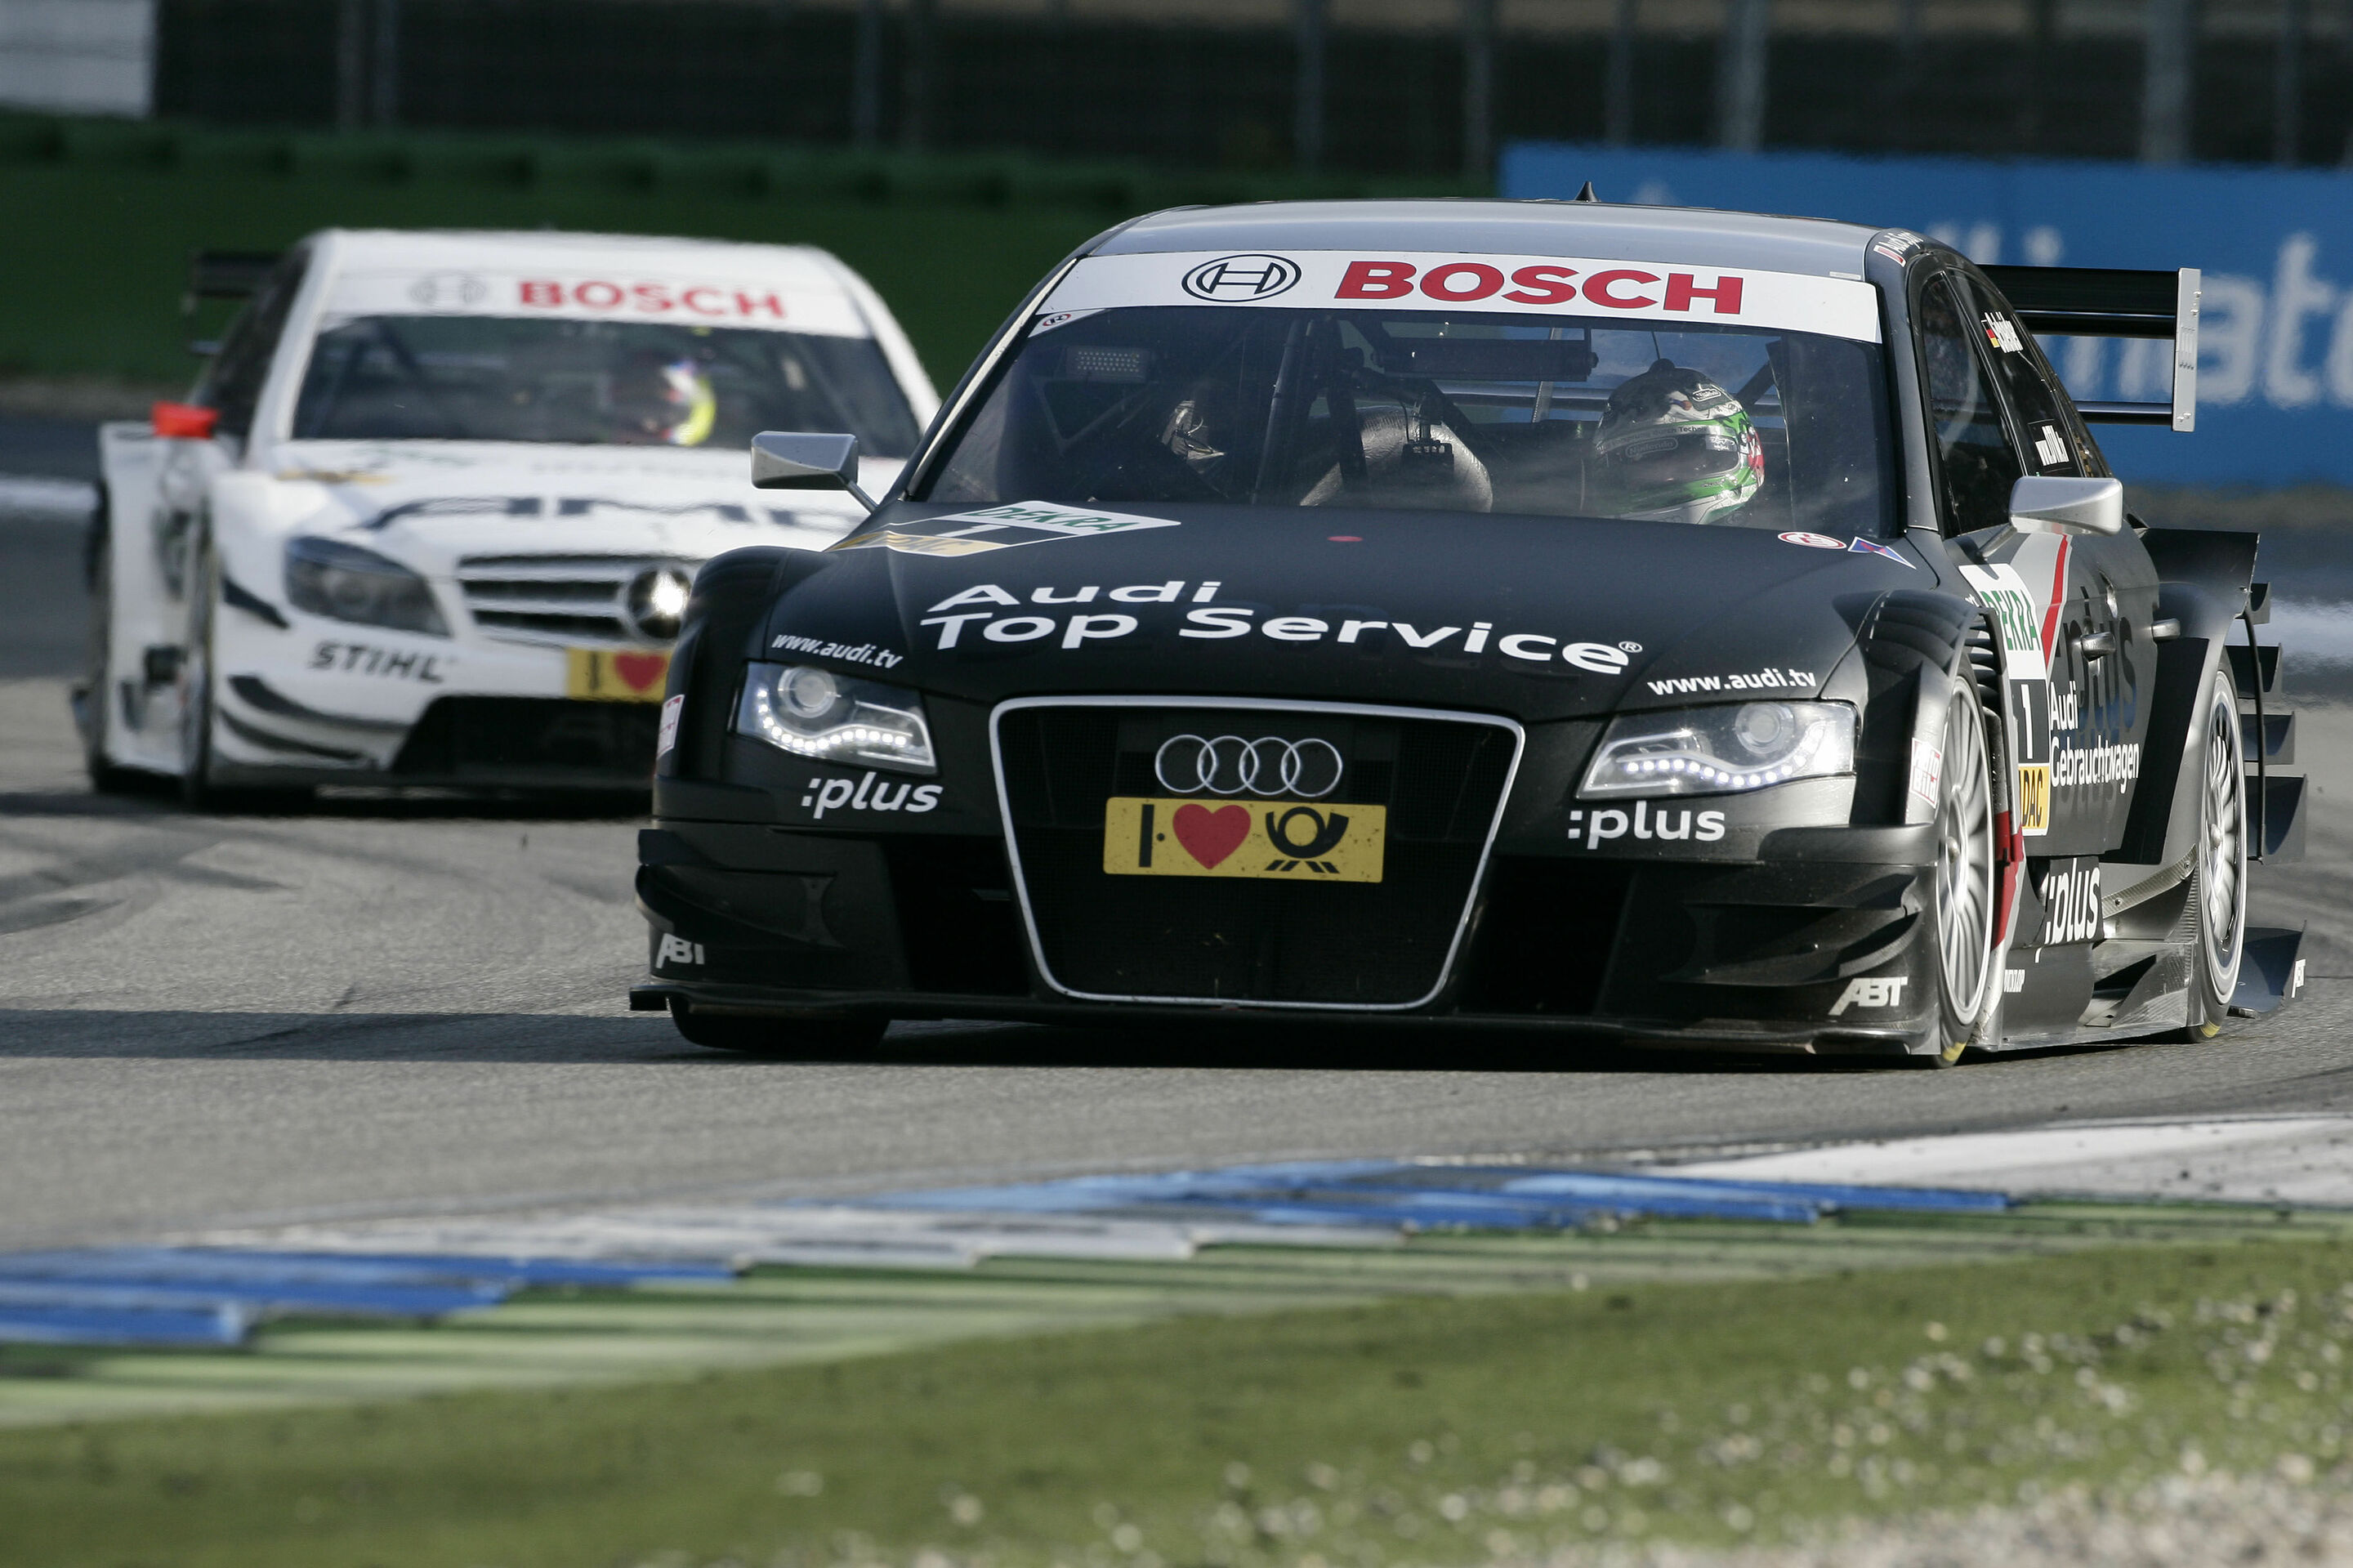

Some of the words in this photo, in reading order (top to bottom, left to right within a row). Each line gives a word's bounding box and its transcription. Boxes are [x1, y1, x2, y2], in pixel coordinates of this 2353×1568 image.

[518, 279, 784, 319] BOSCH
[1333, 259, 1744, 315] BOSCH
[961, 507, 1141, 532] DEKRA
[926, 580, 1222, 613] Audi
[310, 640, 444, 684] STIHL
[771, 634, 903, 668] www.audi.tv
[919, 605, 1139, 651] Top
[1178, 606, 1631, 675] Service
[1647, 668, 1817, 695] www.audi.tv
[2020, 684, 2034, 760] 1
[2051, 680, 2078, 730] Audi
[2051, 735, 2140, 794] Gebrauchtwagen
[801, 771, 944, 819] :plus
[1568, 801, 1726, 849] :plus
[1828, 976, 1908, 1016] ABT
